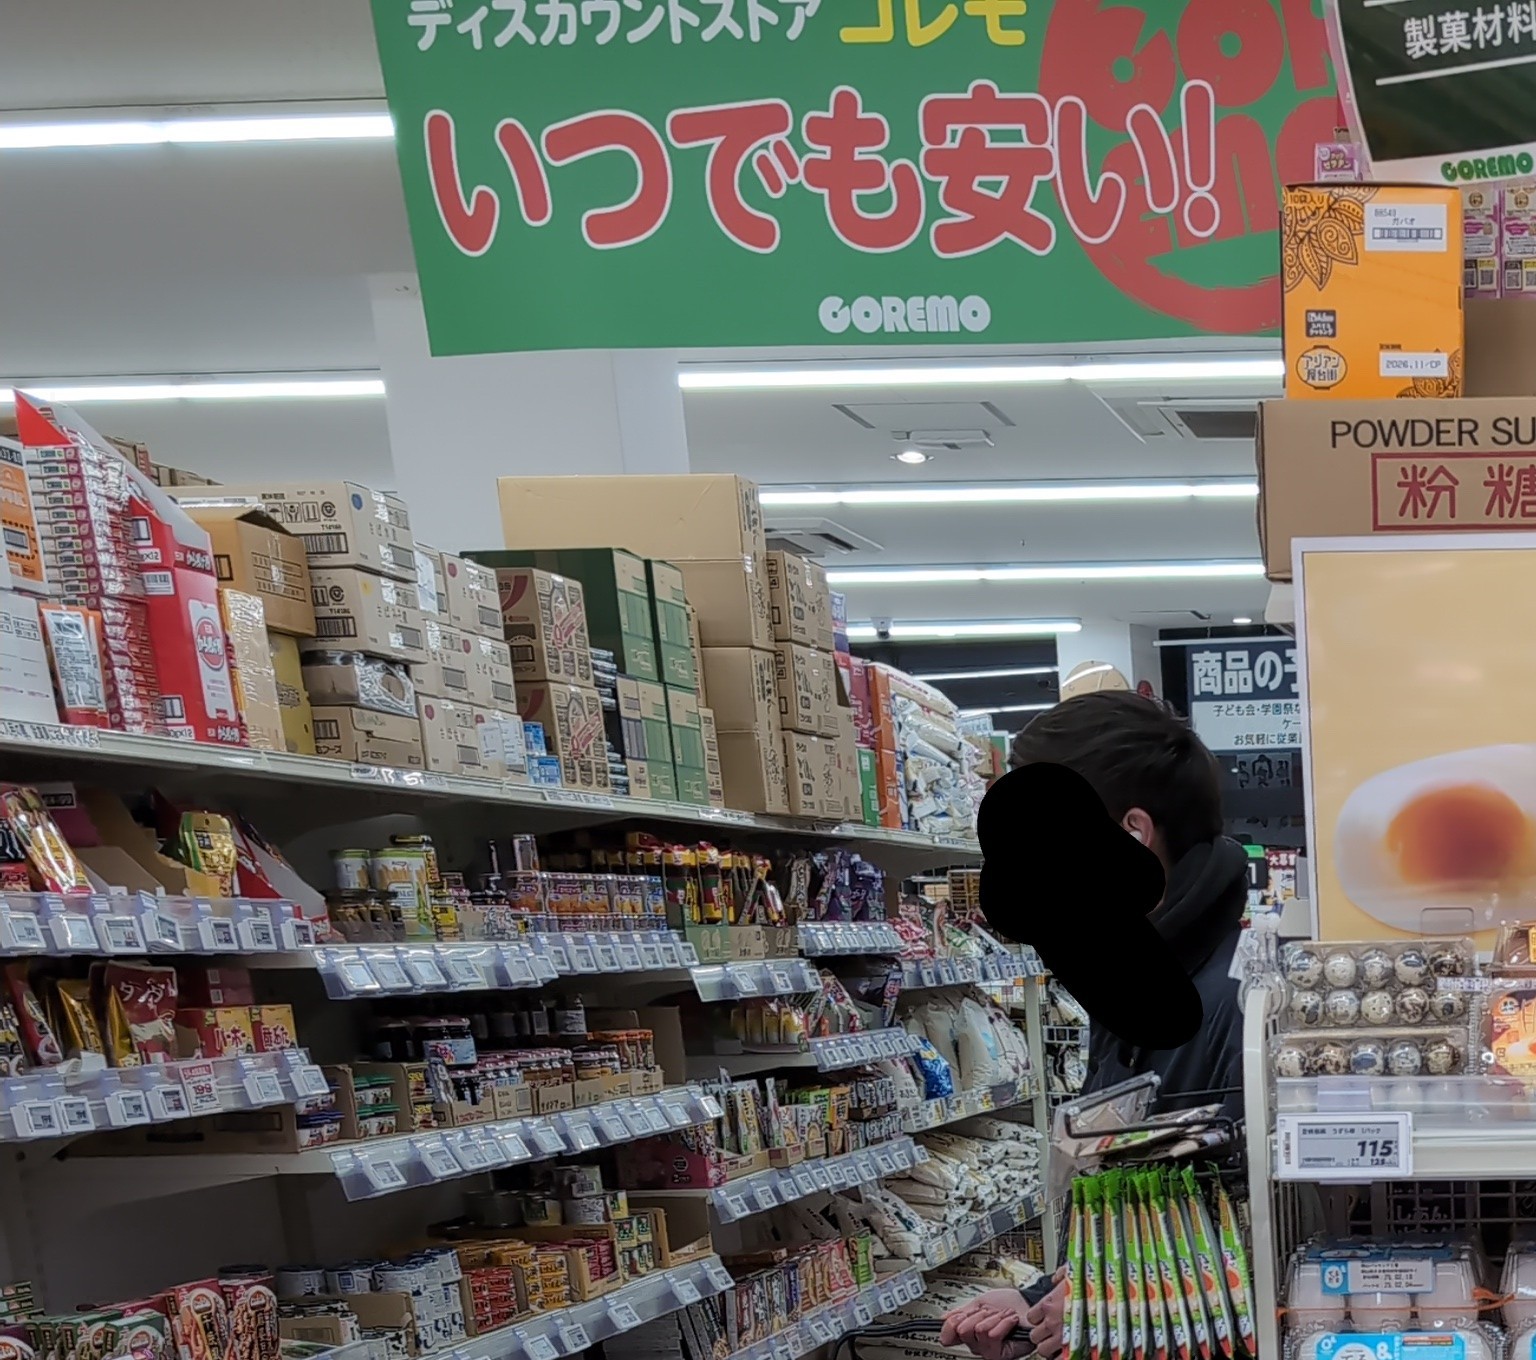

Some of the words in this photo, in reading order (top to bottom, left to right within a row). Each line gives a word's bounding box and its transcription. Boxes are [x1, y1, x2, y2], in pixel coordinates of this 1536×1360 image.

[1330, 419, 1479, 449] POWDER
[1233, 733, 1301, 747] お気軽に従業
[1357, 1140, 1394, 1157] 115
